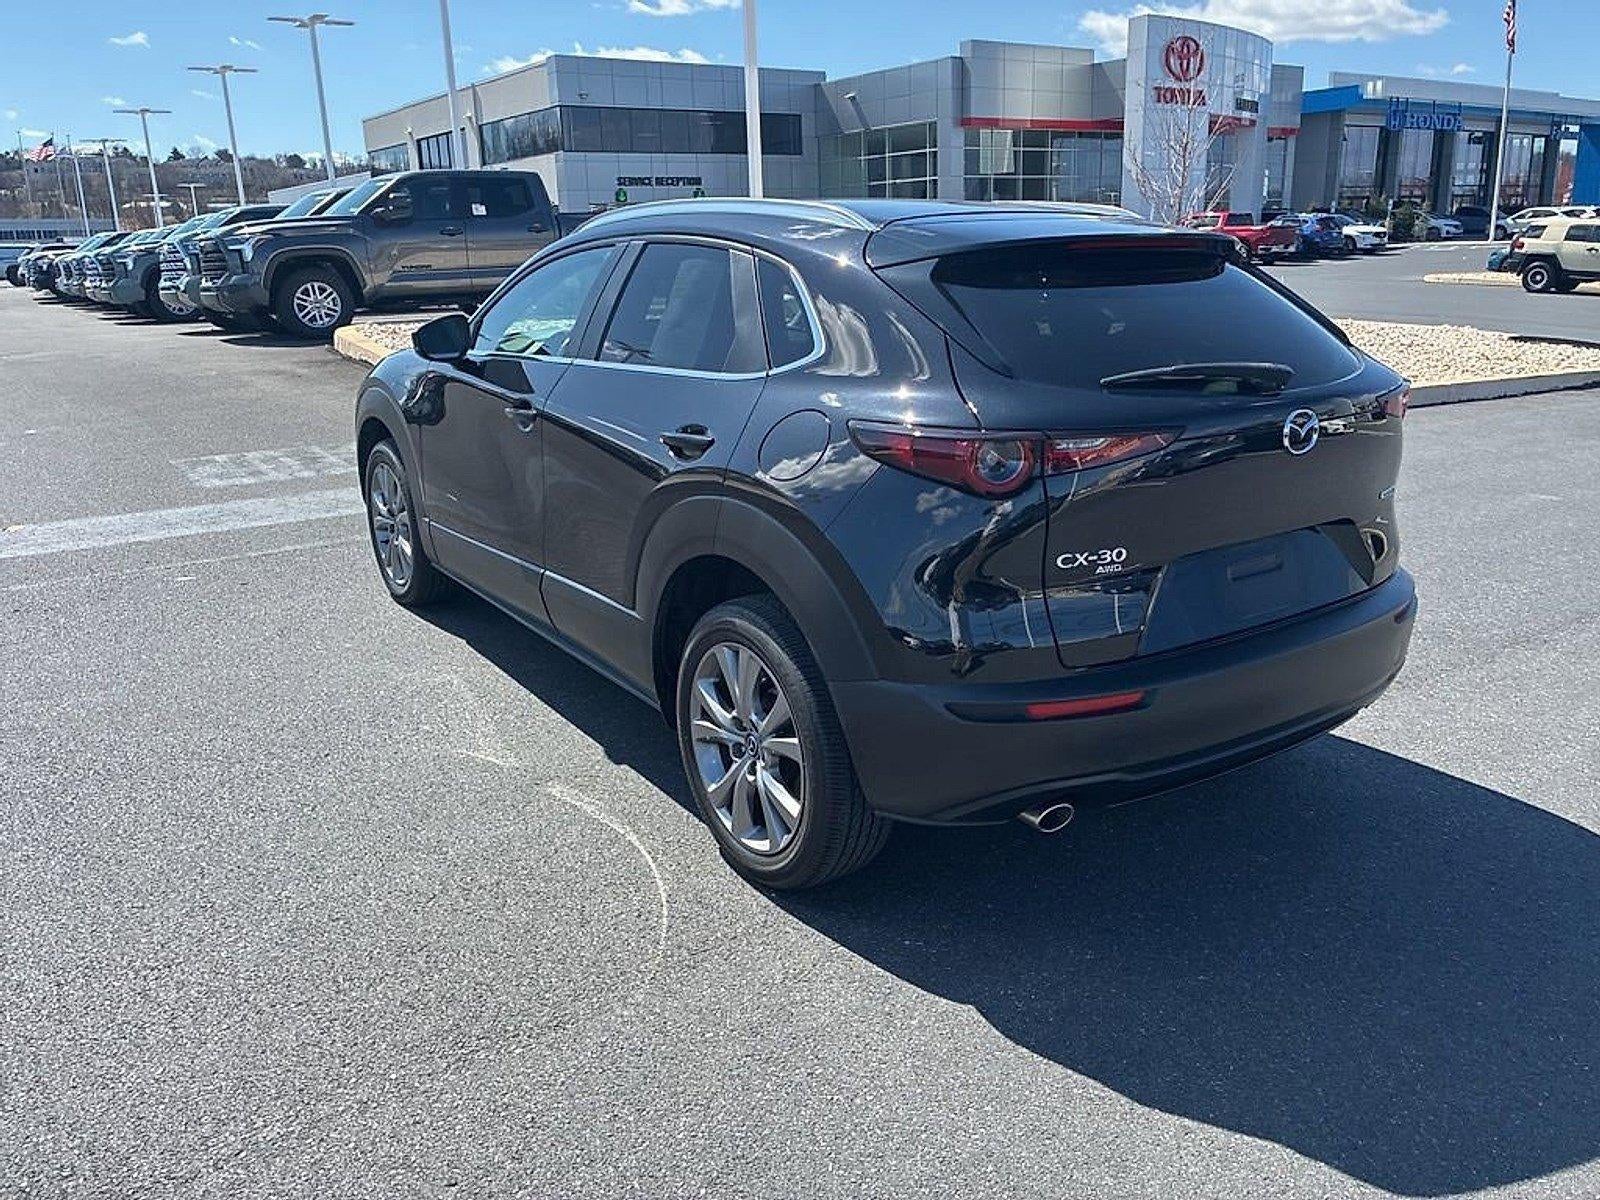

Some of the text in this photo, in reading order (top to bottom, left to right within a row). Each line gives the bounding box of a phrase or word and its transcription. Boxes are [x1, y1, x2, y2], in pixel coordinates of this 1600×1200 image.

[1404, 112, 1463, 131] HONDA
[617, 176, 703, 187] SERVICE RECEPTION
[1056, 547, 1127, 569] CX-30
[1095, 564, 1122, 575] AWD
